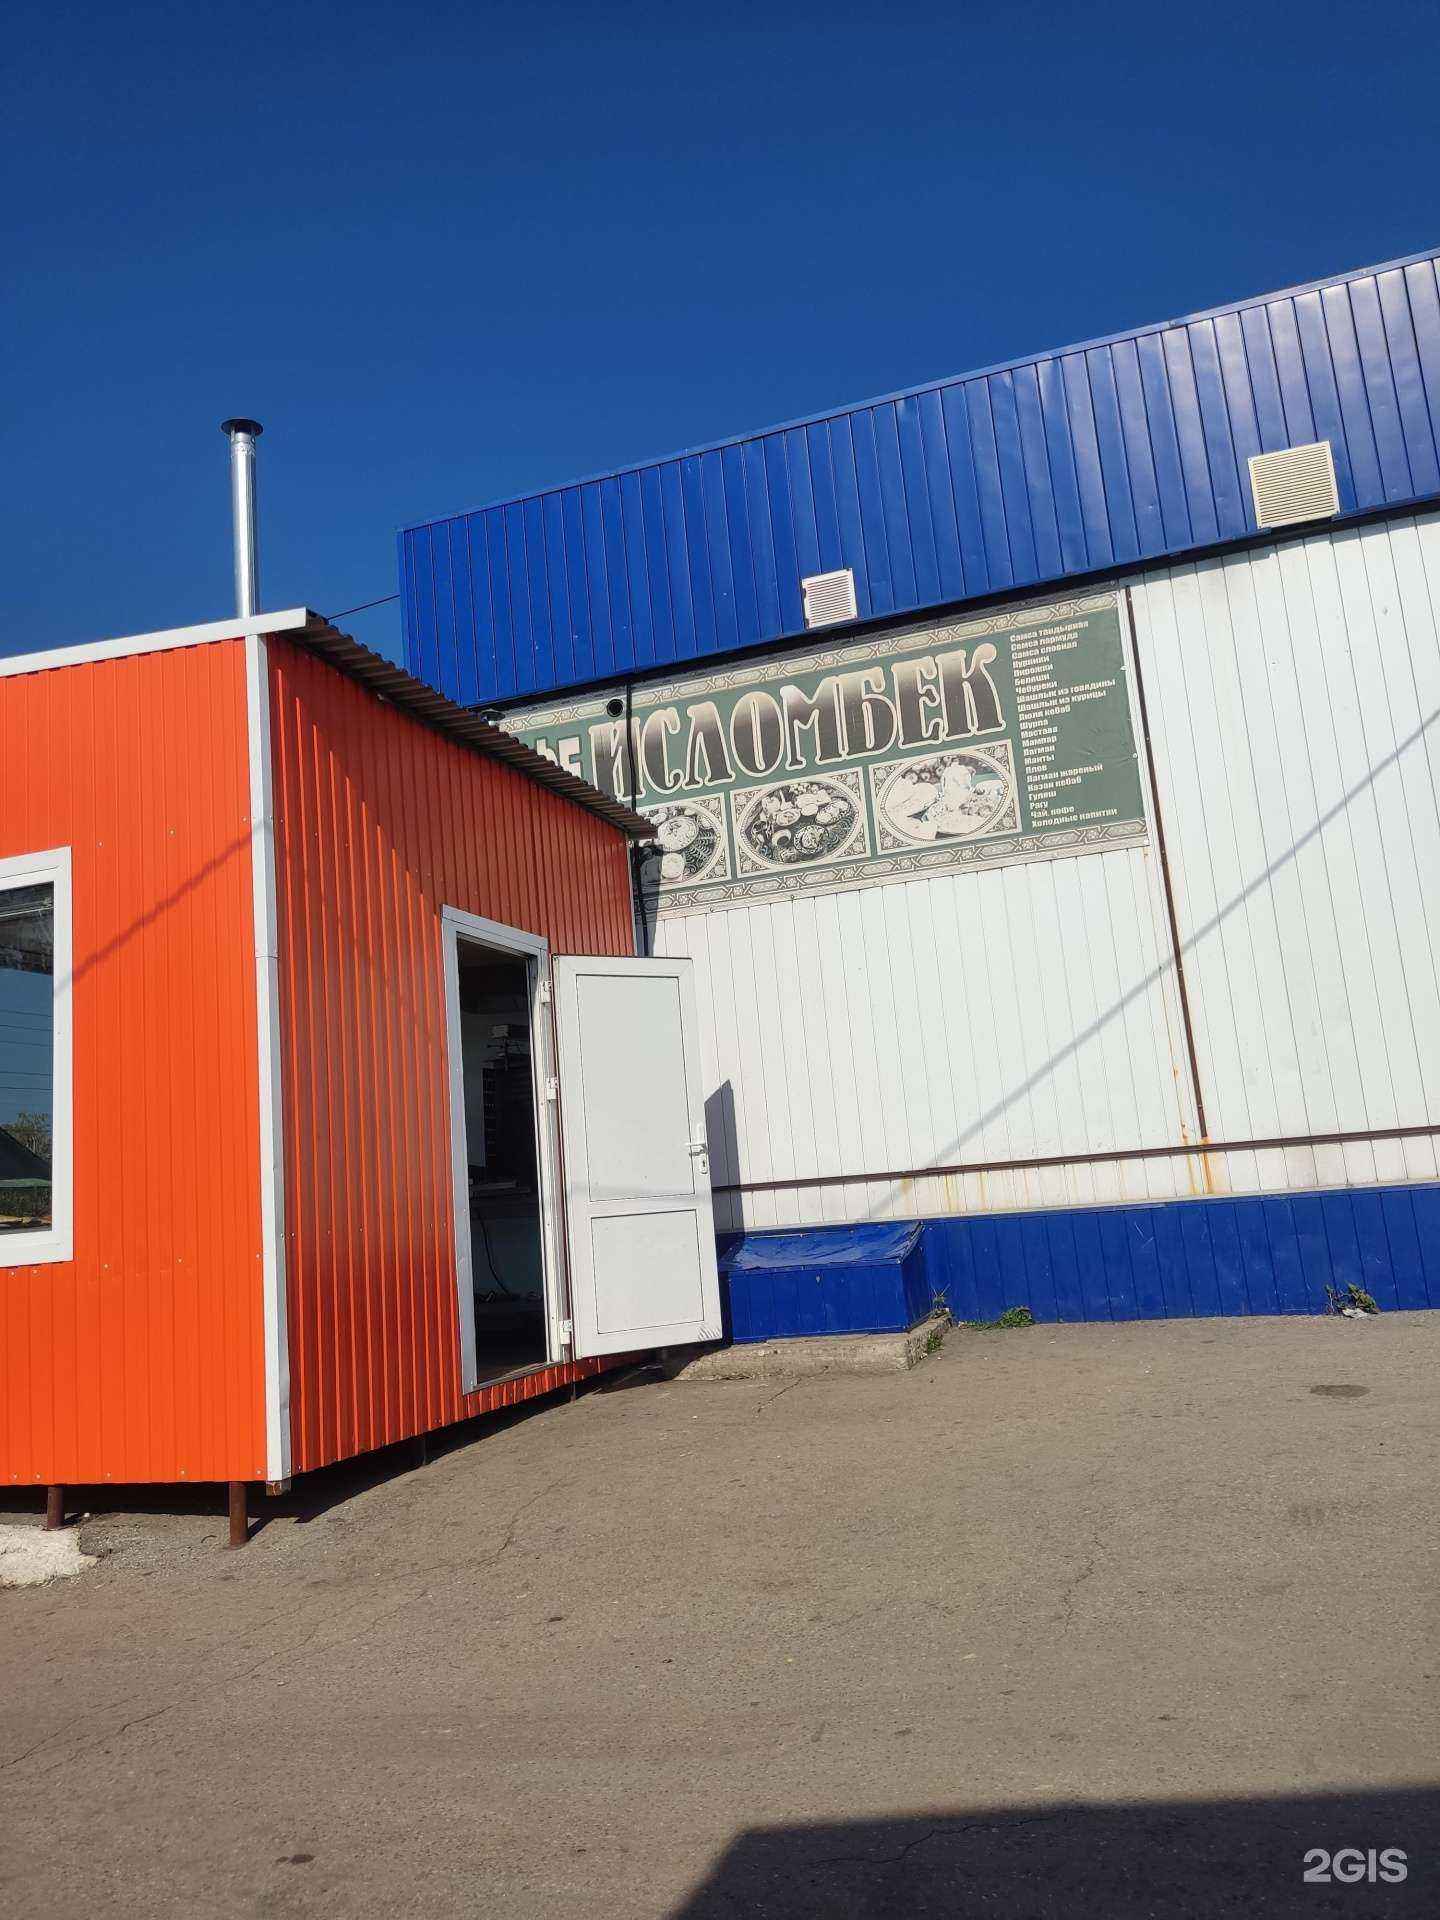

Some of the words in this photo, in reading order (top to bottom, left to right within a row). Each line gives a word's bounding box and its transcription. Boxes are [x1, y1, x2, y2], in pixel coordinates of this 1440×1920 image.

[1010, 632, 1037, 642] Самса
[1011, 640, 1039, 651] Самса
[1012, 649, 1039, 659] Самса
[1014, 674, 1050, 686] Беляши
[1015, 681, 1058, 694] Чебуреки
[1017, 690, 1057, 704] Шашлык
[1058, 688, 1069, 696] из
[1070, 679, 1116, 694] говядины
[1018, 699, 1058, 712] Шашлык
[1059, 696, 1070, 704] из
[1071, 690, 1106, 702] курицы
[1019, 710, 1044, 721] Люля
[588, 642, 1006, 801] ИСЛОМБЕК
[1020, 719, 1049, 730] Шурпа
[1023, 745, 1055, 757] Лагман
[1024, 754, 1055, 766] Манты
[1025, 764, 1047, 774] Плов
[1027, 772, 1058, 783] Лагман
[1028, 790, 1057, 801] Гуляш
[1029, 800, 1048, 810] Рагу
[1050, 806, 1075, 816] кофе
[1032, 814, 1078, 828] Холодные
